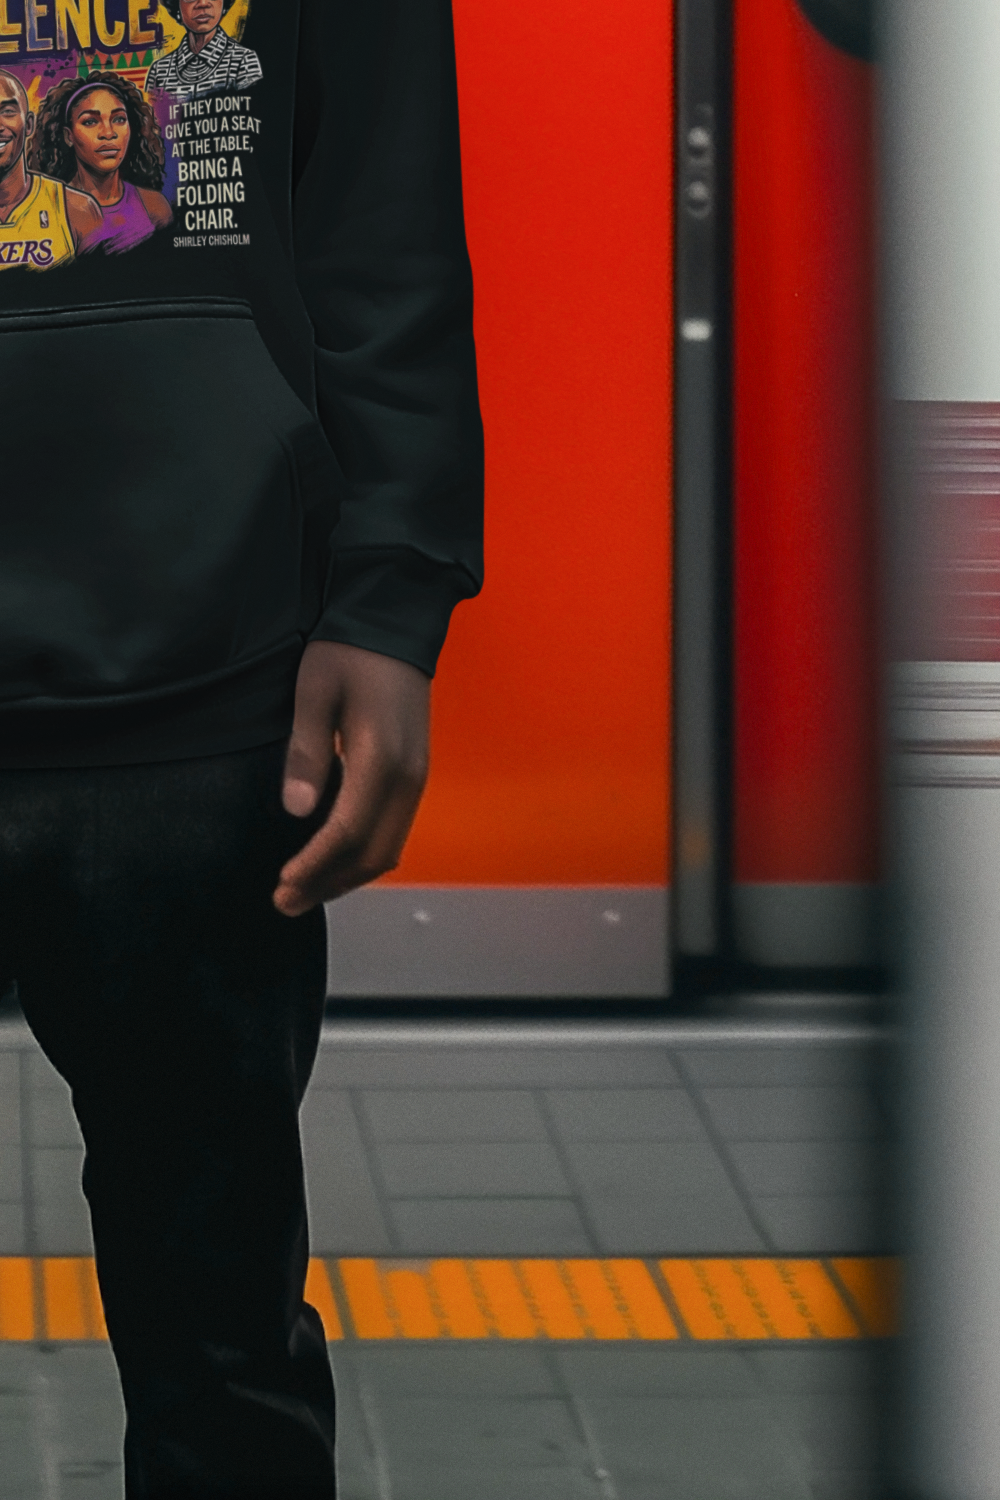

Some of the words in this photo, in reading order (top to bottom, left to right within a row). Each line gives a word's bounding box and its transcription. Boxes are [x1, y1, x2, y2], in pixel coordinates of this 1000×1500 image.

[169, 105, 180, 120] IF
[182, 99, 212, 118] THEY
[216, 96, 251, 112] DON'T
[165, 122, 191, 139] GIVE
[194, 117, 217, 135] YOU
[221, 117, 229, 131] A
[232, 116, 261, 134] SEAT
[172, 142, 185, 158] AT
[188, 138, 210, 155] THE
[213, 135, 253, 153] TABLE,
[178, 158, 227, 182] BRING
[232, 156, 242, 177] A
[177, 182, 245, 206] FOLDING
[185, 208, 238, 230] CHAIR.
[174, 236, 206, 247] SHIRLEY
[209, 234, 250, 246] CHISHOLM
